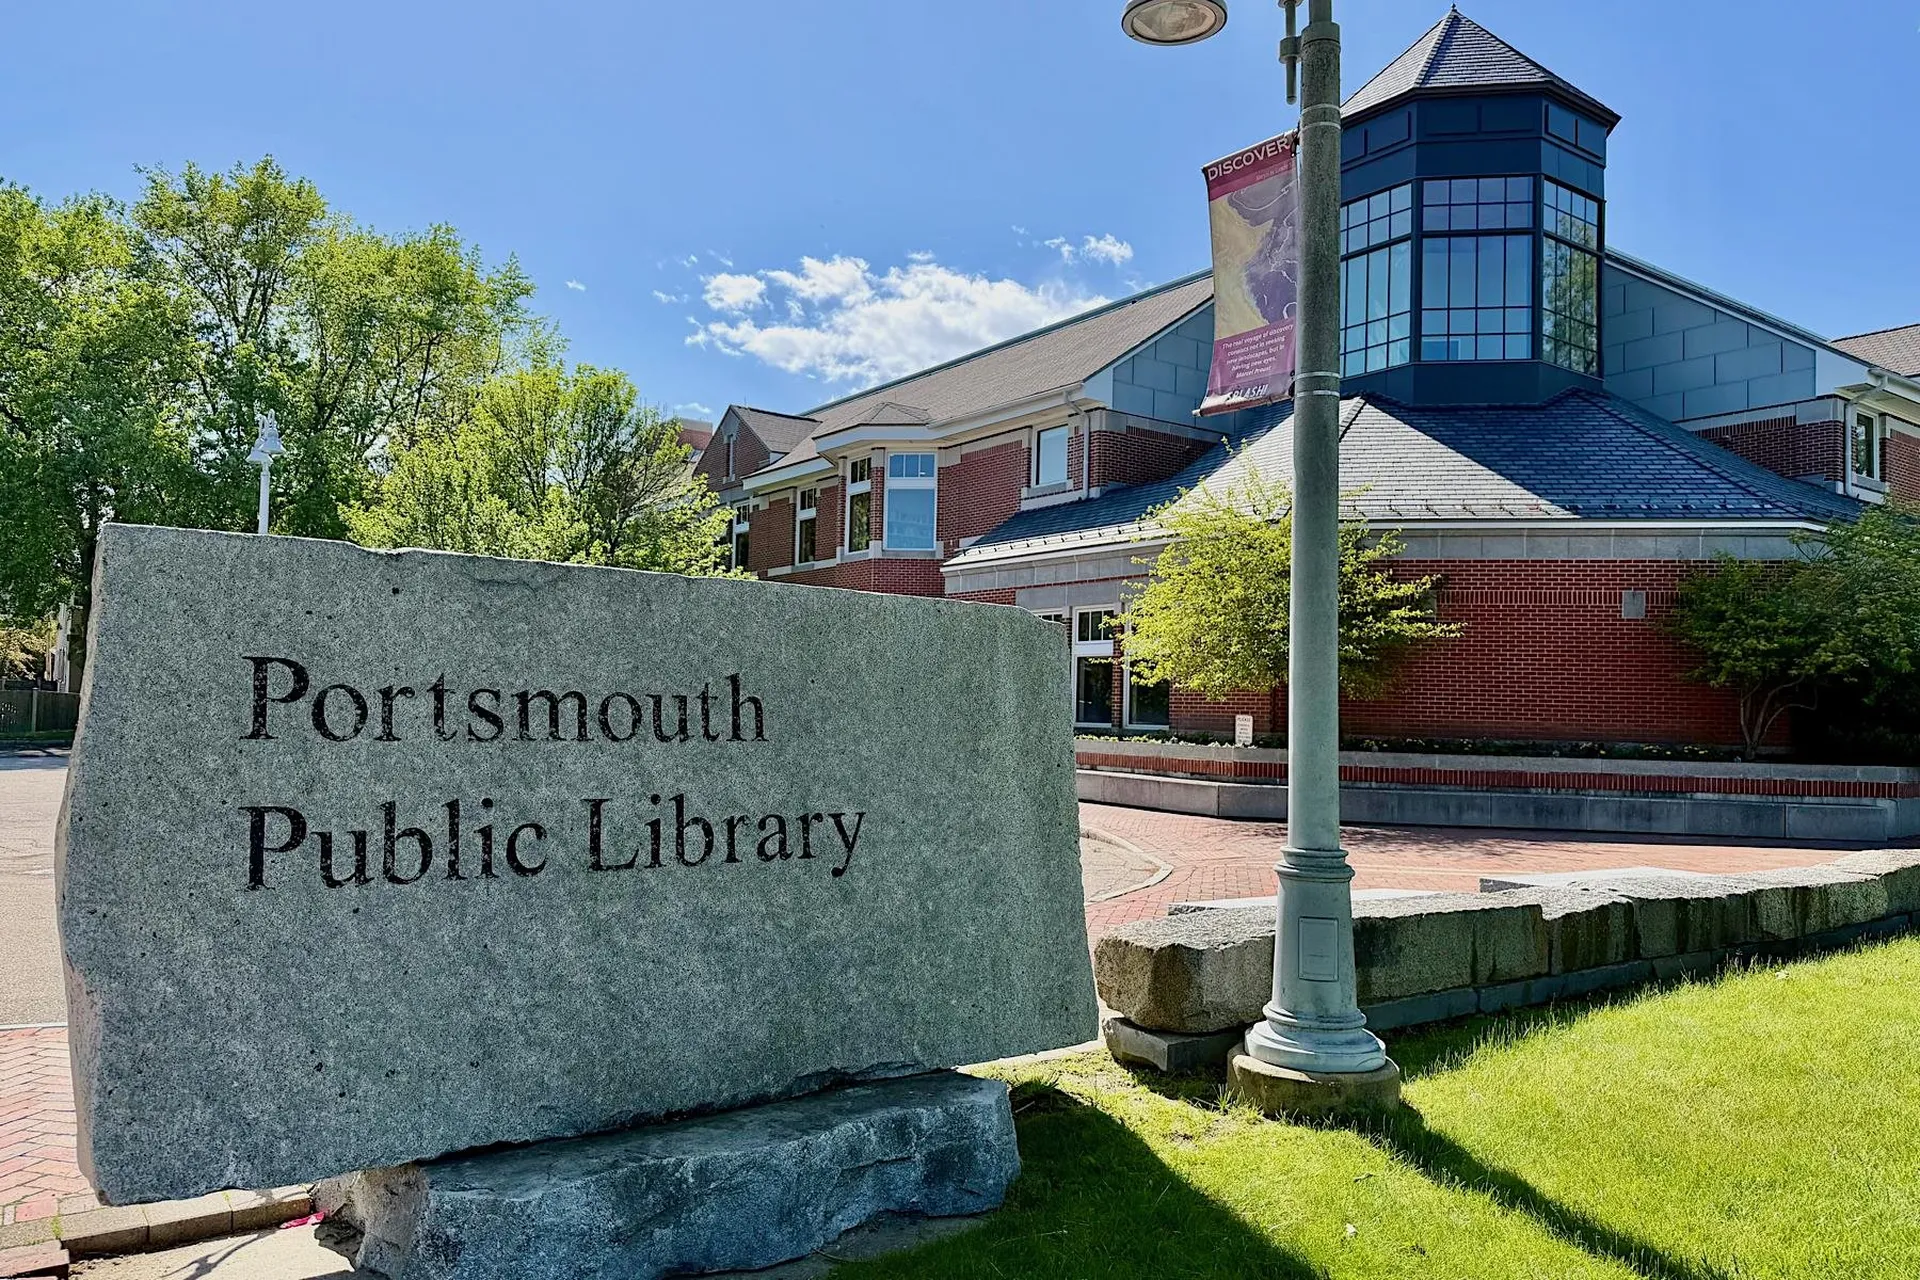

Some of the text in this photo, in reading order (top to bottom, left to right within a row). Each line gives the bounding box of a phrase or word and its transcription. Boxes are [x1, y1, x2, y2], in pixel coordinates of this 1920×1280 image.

[1208, 138, 1291, 180] DISCOVER
[239, 655, 770, 743] Portsmouth
[237, 794, 867, 892] Public Library
